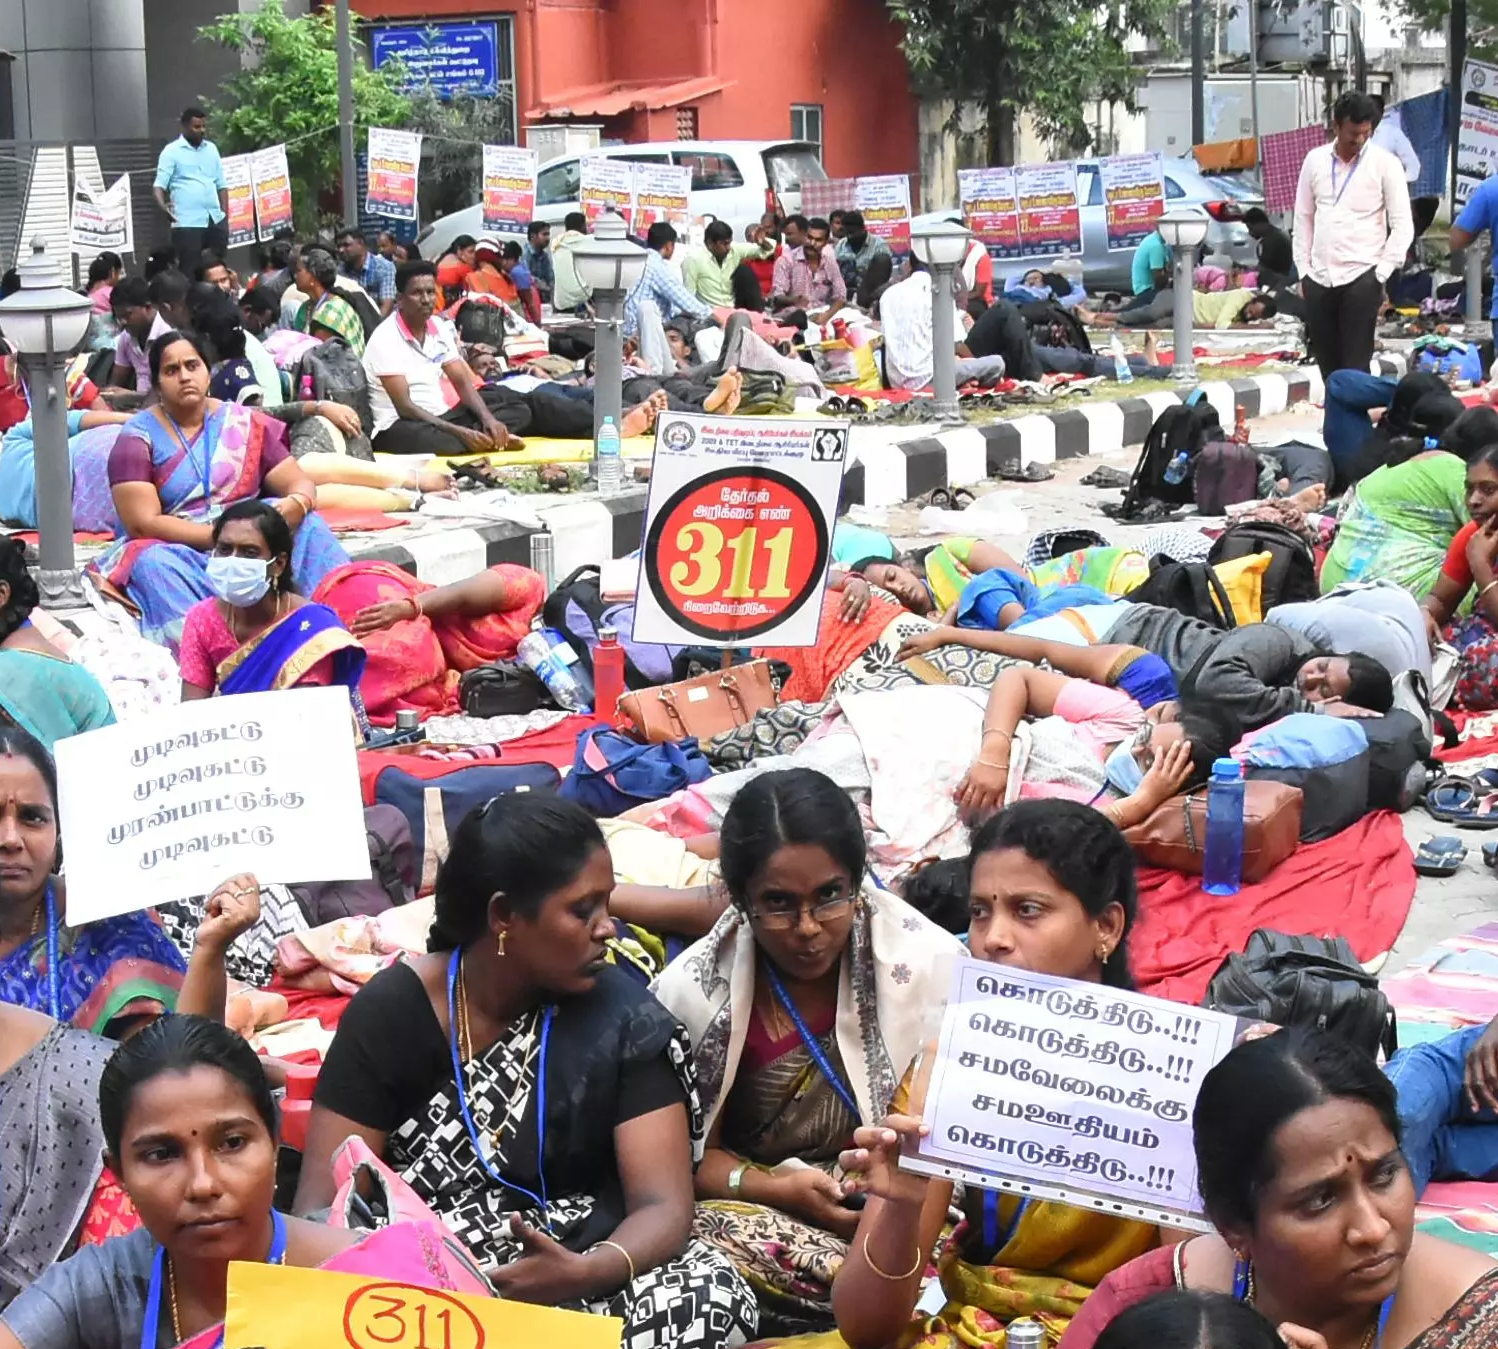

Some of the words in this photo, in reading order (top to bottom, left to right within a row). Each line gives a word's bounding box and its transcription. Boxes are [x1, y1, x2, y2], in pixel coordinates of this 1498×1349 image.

[693, 503, 754, 520] அறிக்கை
[759, 505, 792, 521] எண்
[720, 487, 771, 505] தேர்தல்
[670, 521, 794, 598] 311
[107, 787, 306, 844] முரண்பாட்டுக்கு
[976, 975, 1202, 1045] கொடுத்திடு..!!!
[968, 1012, 1194, 1084] கொடுத்திடு..!!!
[958, 1050, 1189, 1123] சமவேலைக்கு
[971, 1093, 1160, 1149] சமஊதியம்
[947, 1124, 1175, 1192] கொடுத்திடு..!!!
